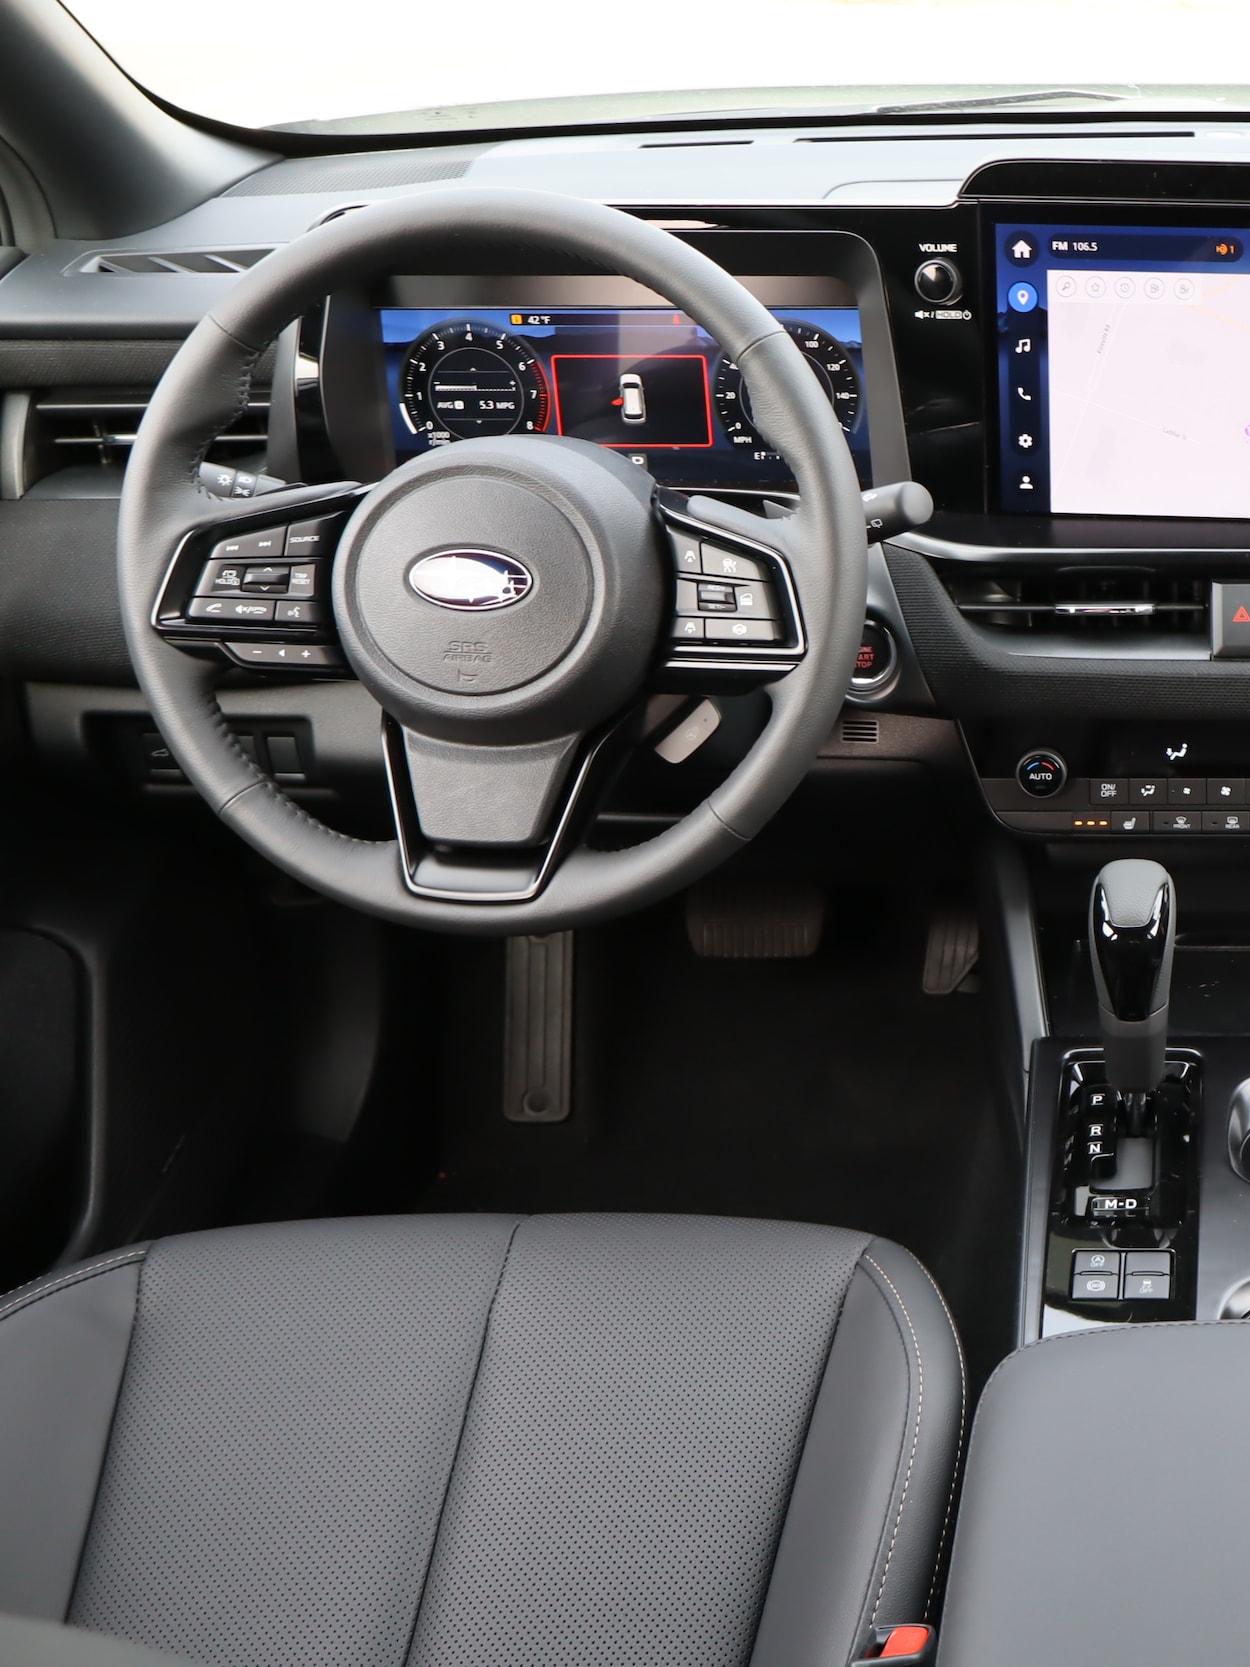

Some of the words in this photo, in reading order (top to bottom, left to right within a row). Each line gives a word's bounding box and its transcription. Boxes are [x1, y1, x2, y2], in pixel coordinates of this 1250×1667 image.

[918, 243, 958, 253] VOLUME
[1052, 240, 1068, 251] FM
[1073, 242, 1098, 251] 106.5
[465, 333, 473, 341] 4
[437, 341, 445, 350] 3
[496, 341, 504, 349] 5
[418, 362, 427, 371] 2
[518, 362, 526, 371] 6
[416, 392, 422, 400] 1
[530, 390, 537, 399] 7
[480, 401, 494, 409] 5.3
[426, 421, 433, 430] 0
[526, 421, 534, 430] 8
[289, 535, 320, 543] SOURCE
[448, 640, 488, 652] SRS
[443, 653, 492, 663] AIRBAG
[858, 653, 874, 661] ART
[1029, 772, 1052, 781] AUTO
[1101, 783, 1116, 791] ON/
[1092, 1095, 1102, 1104] P
[1091, 1126, 1101, 1135] R
[1089, 1144, 1101, 1153] N
